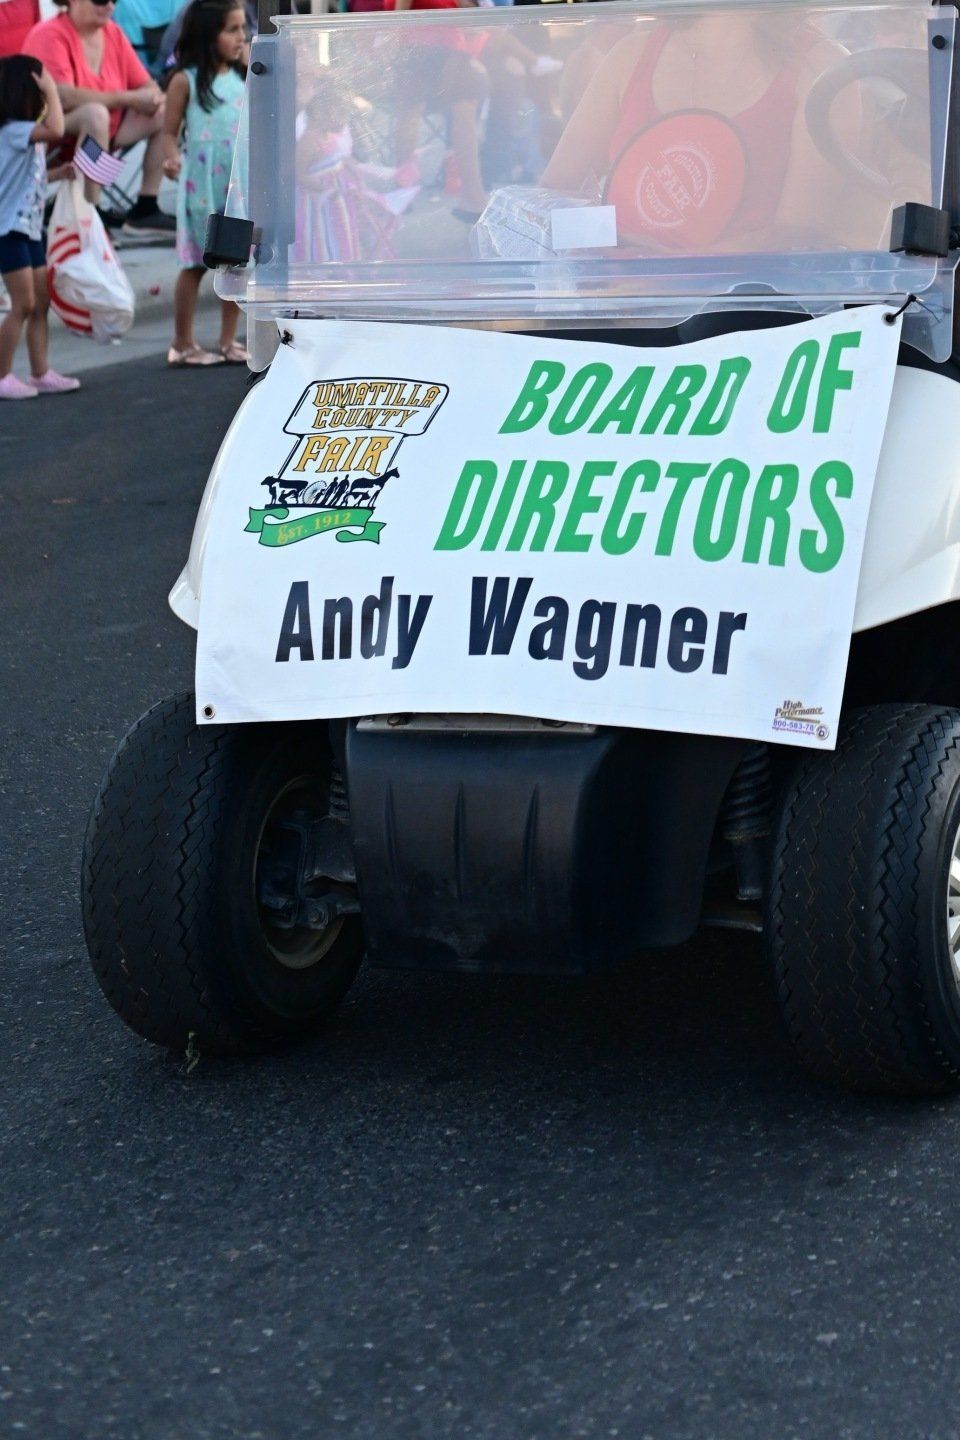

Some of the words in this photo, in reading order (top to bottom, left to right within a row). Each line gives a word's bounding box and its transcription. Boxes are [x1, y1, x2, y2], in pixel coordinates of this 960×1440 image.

[312, 382, 442, 408] UMATILLA
[497, 356, 752, 436] BOARD
[766, 331, 862, 433] OF
[312, 407, 420, 429] COUNTY
[293, 434, 395, 476] FAIR
[313, 512, 352, 530] 1912
[433, 457, 854, 574] DIRECTORS
[275, 577, 434, 670] Andy
[468, 577, 748, 681] Wagner
[775, 707, 824, 717] Performance
[782, 700, 803, 710] High
